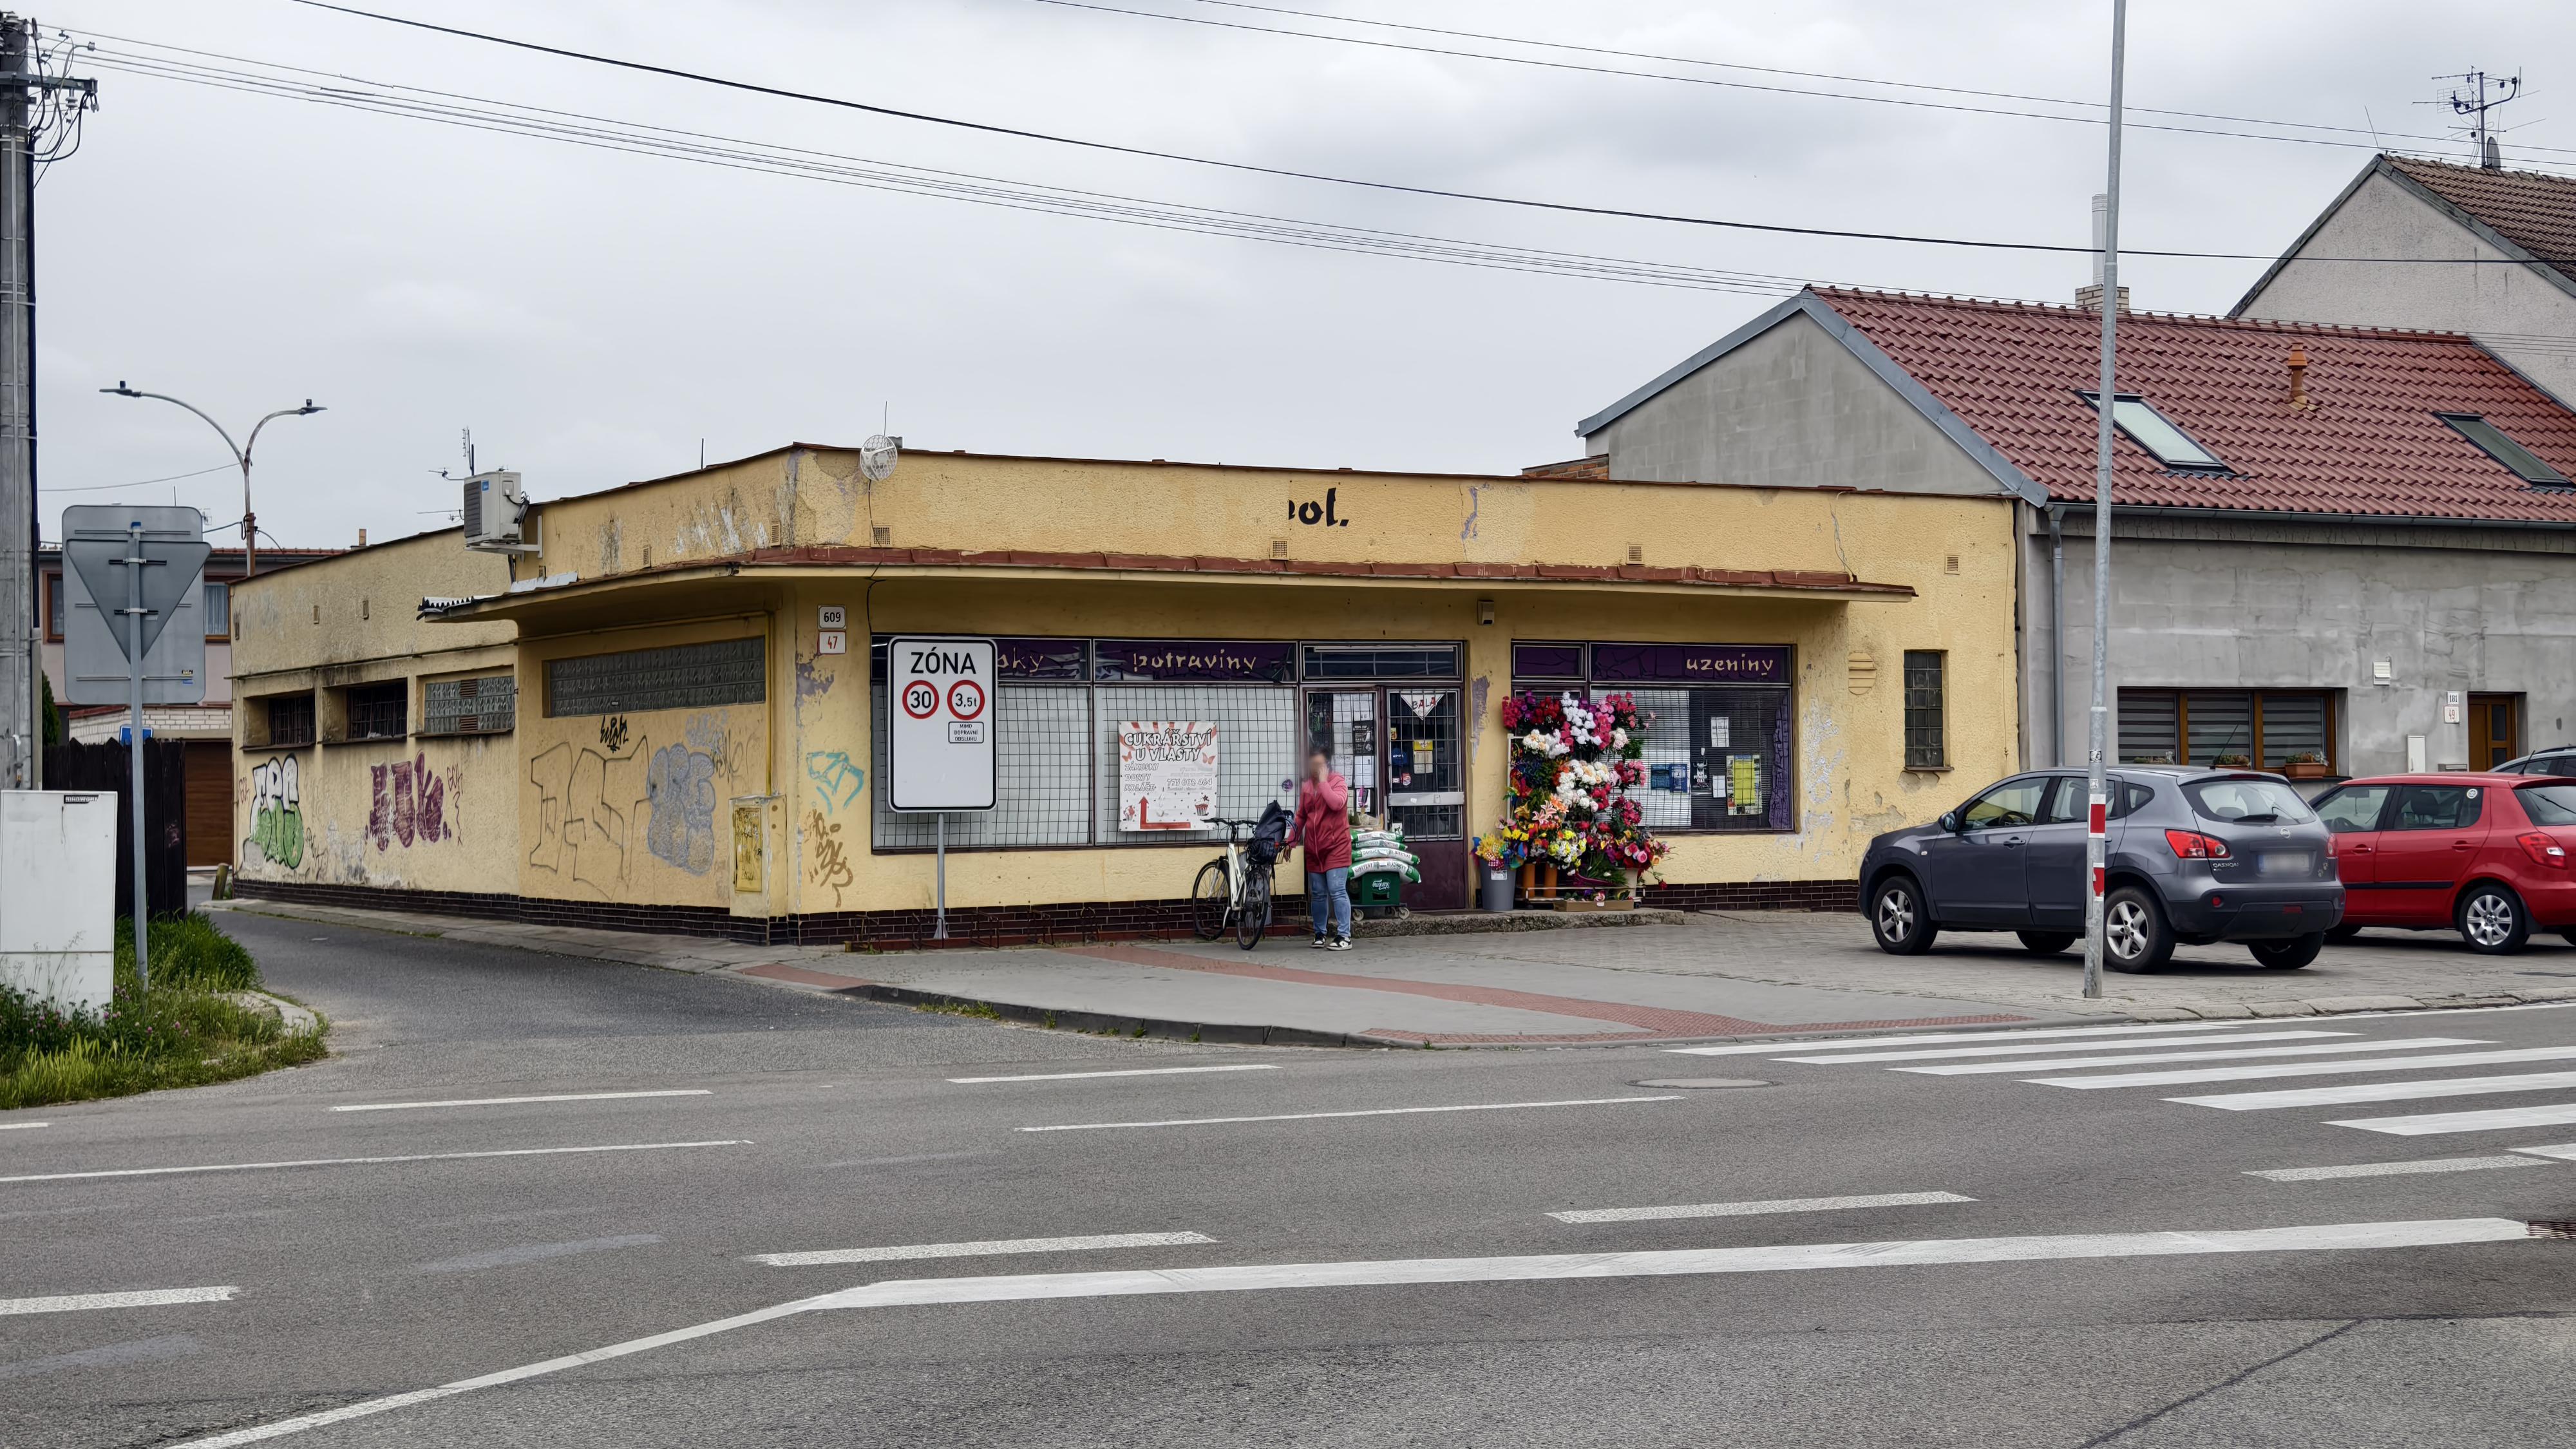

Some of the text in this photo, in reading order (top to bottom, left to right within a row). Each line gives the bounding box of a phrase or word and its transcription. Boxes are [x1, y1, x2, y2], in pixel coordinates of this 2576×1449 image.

[824, 612, 841, 623] 609
[828, 635, 838, 650] 47
[910, 646, 977, 675] ZÓNA
[1686, 653, 1774, 676] uzeniny
[910, 690, 932, 709] 30
[2449, 710, 2455, 719] 49
[1124, 728, 1212, 746] CUKRÁŘSTVÍ
[1135, 747, 1201, 762] U VLASTY
[1124, 761, 1159, 771] ZÁKUSKY
[1124, 781, 1155, 791] KOLÁČE
[1166, 778, 1180, 786] 775
